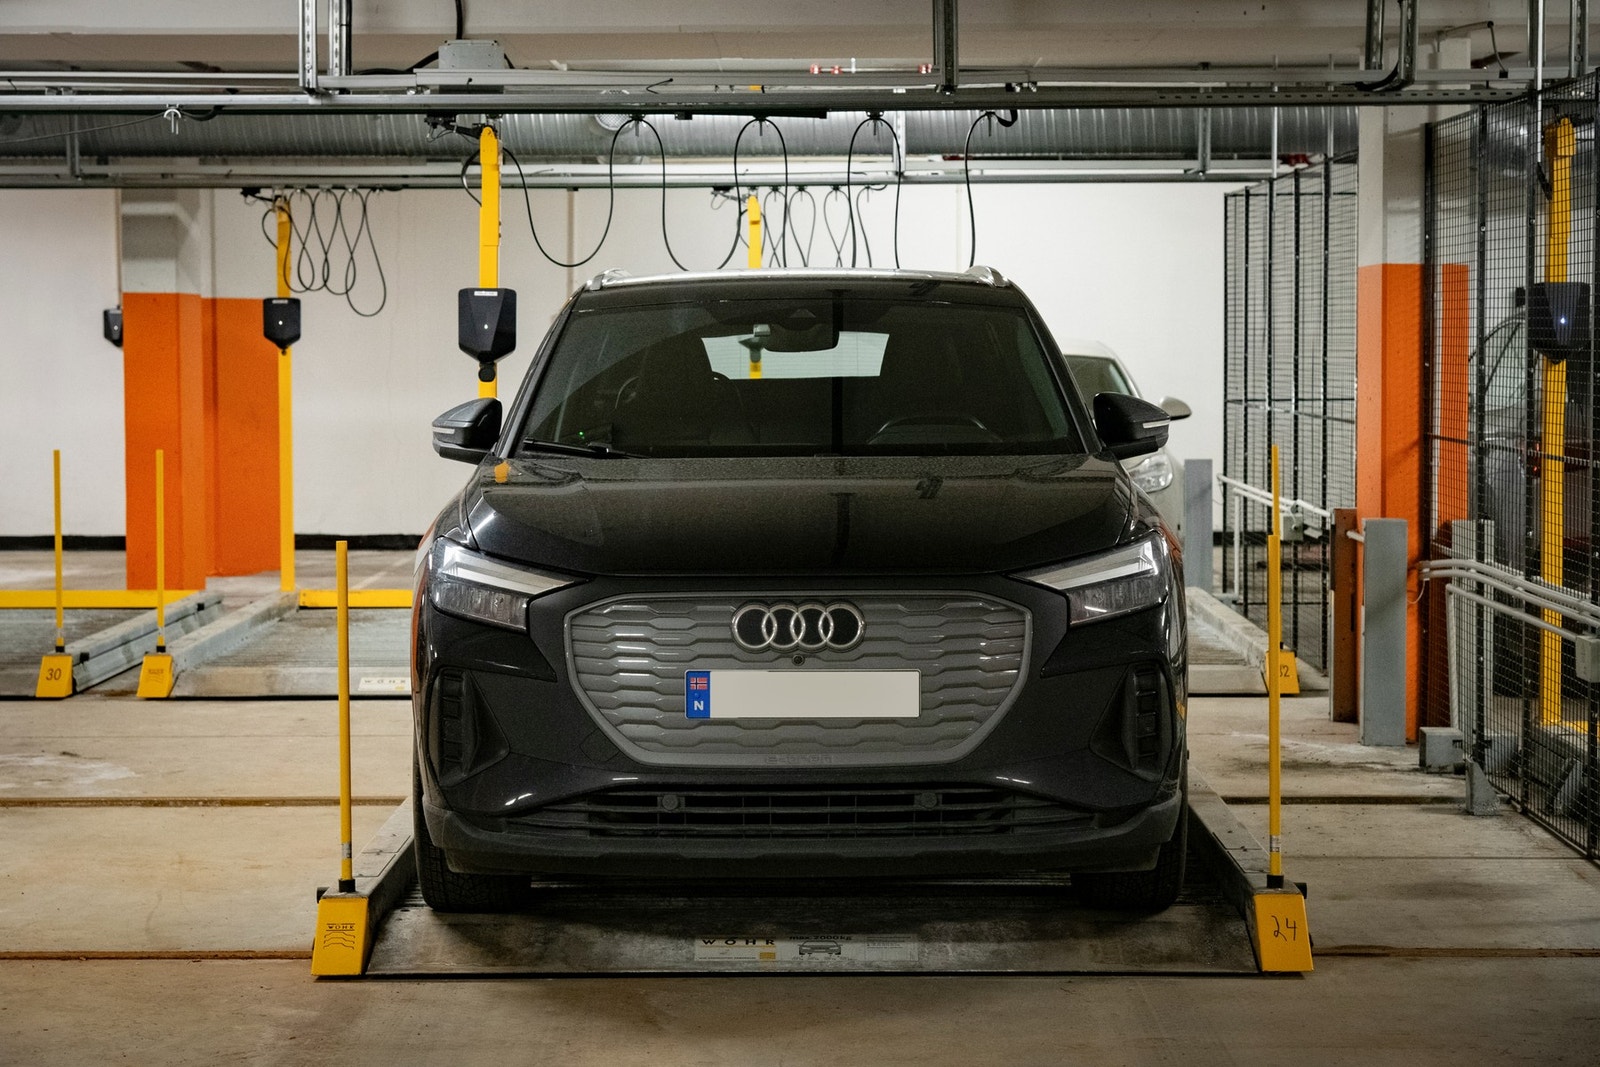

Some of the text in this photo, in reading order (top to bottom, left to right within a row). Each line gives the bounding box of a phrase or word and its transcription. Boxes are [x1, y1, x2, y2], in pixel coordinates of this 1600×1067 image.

[46, 667, 62, 681] 30
[693, 700, 704, 711] N
[1271, 915, 1297, 941] 24
